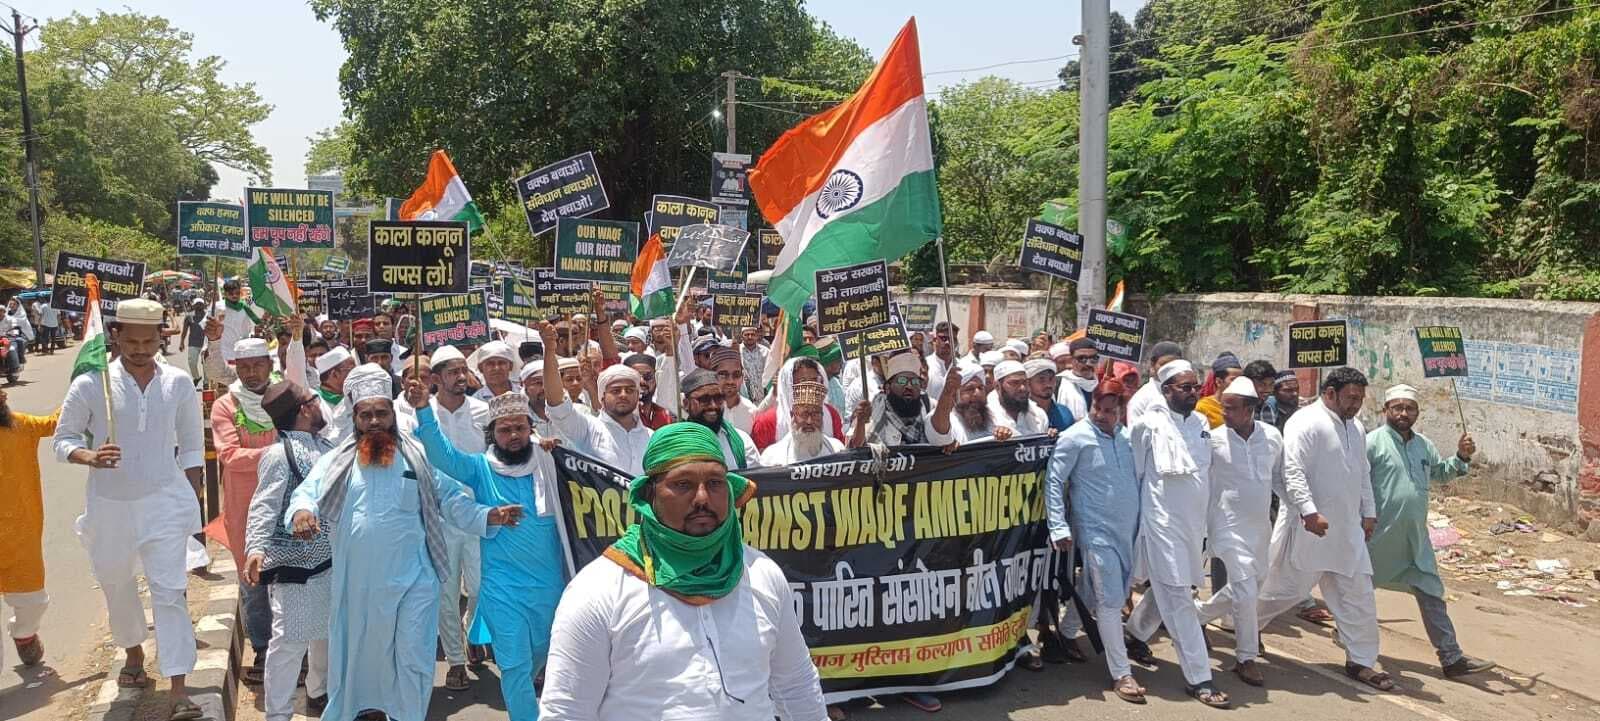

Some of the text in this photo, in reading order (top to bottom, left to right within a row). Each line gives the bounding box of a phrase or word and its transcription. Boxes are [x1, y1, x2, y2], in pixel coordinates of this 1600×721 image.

[252, 192, 329, 207] WE WILL NOT BE
[268, 209, 315, 222] SILENCED
[657, 201, 685, 215] काला
[686, 203, 718, 226] कानून
[576, 225, 622, 242] OUR WAQF
[660, 226, 682, 239] वाप
[762, 234, 784, 246] काल
[374, 226, 464, 257] काला कानून
[576, 242, 622, 257] OUR RIGHT
[382, 265, 423, 285] वापस
[426, 258, 454, 286] लो!
[561, 258, 592, 272] HANDS
[594, 259, 608, 272] OFF
[851, 264, 882, 279] सरकार
[821, 287, 837, 300] की
[824, 302, 848, 316] नहीं
[823, 318, 848, 332] नहीं
[1291, 325, 1344, 344] काला कानून
[1296, 350, 1322, 364] वापस
[1014, 444, 1036, 463] देश
[568, 480, 635, 538] PROT
[737, 490, 826, 550] AINST
[830, 483, 908, 548] WAQF
[811, 560, 875, 631] पारित
[880, 558, 962, 626] संसोधन
[850, 646, 911, 672] मुस्लिम
[916, 637, 972, 662] कल्याण
